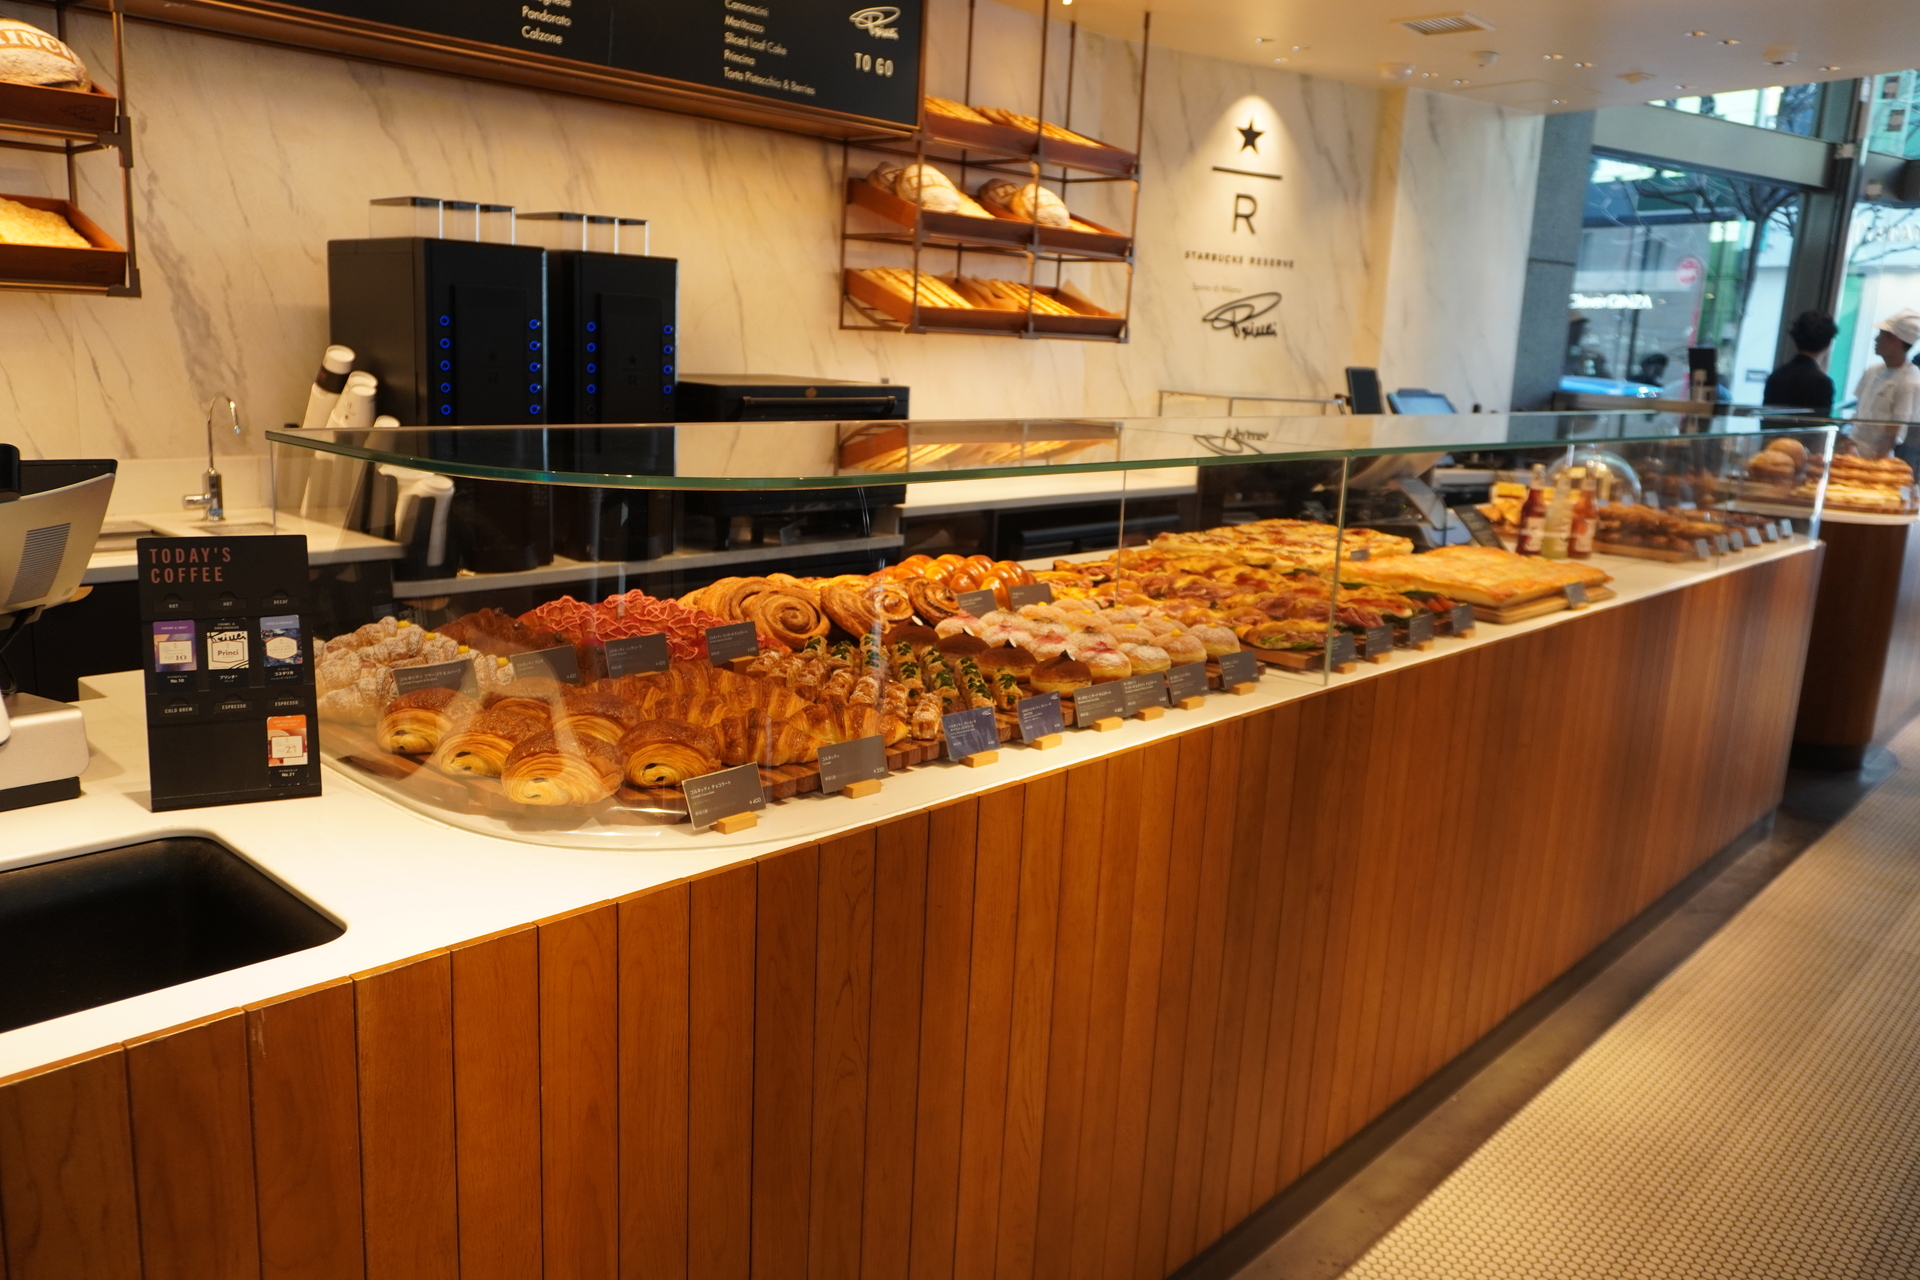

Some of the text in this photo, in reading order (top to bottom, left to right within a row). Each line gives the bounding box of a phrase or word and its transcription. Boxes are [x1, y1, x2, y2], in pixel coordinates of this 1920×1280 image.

[522, 5, 572, 27] Pandorato
[521, 25, 563, 45] Calzone
[854, 52, 894, 78] TO GO
[1233, 193, 1257, 235] R
[1185, 250, 1294, 268] STARBUCKS RESERVE
[150, 547, 231, 564] TODAY'S
[151, 567, 224, 584] COFFEE
